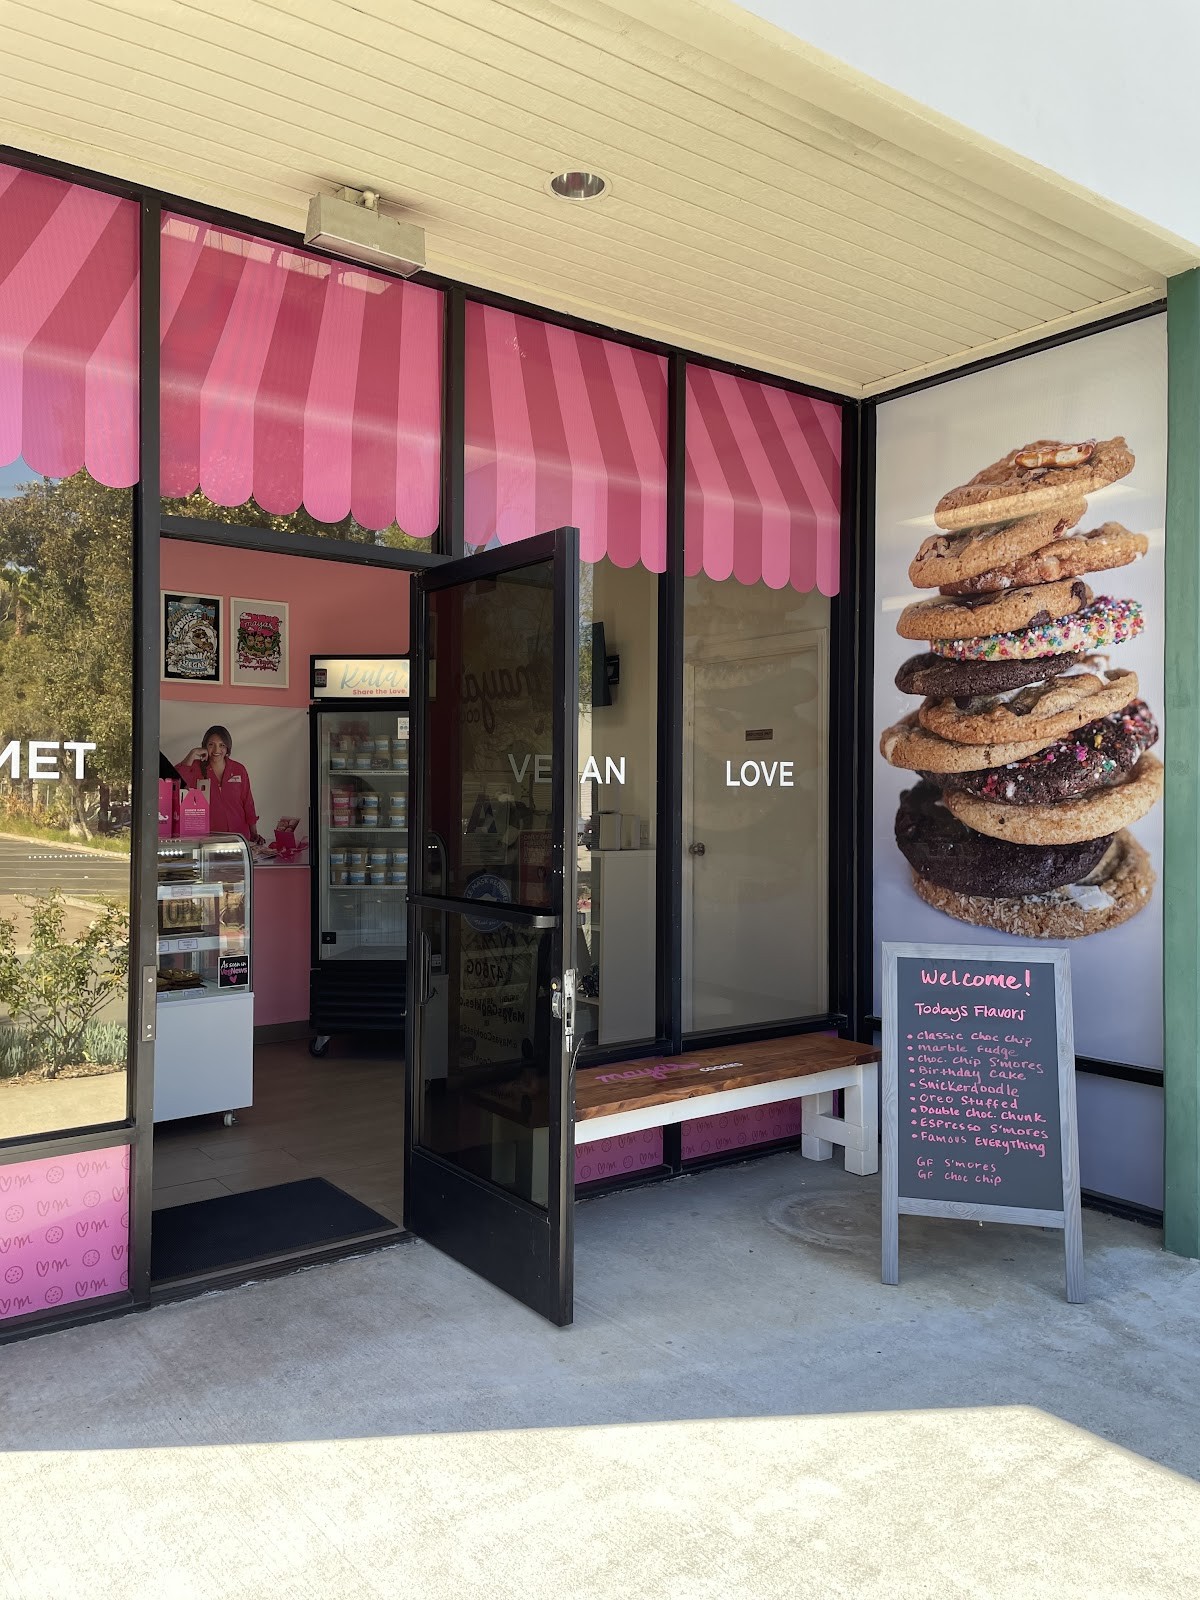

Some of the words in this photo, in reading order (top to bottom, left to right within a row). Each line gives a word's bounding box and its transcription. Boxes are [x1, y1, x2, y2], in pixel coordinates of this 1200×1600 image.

[507, 753, 626, 785] VEAN
[726, 760, 795, 787] LOVE
[220, 960, 228, 969] As
[921, 969, 1031, 997] Welcome!
[914, 1003, 968, 1022] Todays
[973, 1005, 1027, 1021] Flavors
[919, 1066, 982, 1084] Birthday
[961, 1095, 1018, 1109] Stuffed
[920, 1105, 960, 1116] Double
[916, 1157, 934, 1167] GF
[917, 1170, 934, 1179] GF
